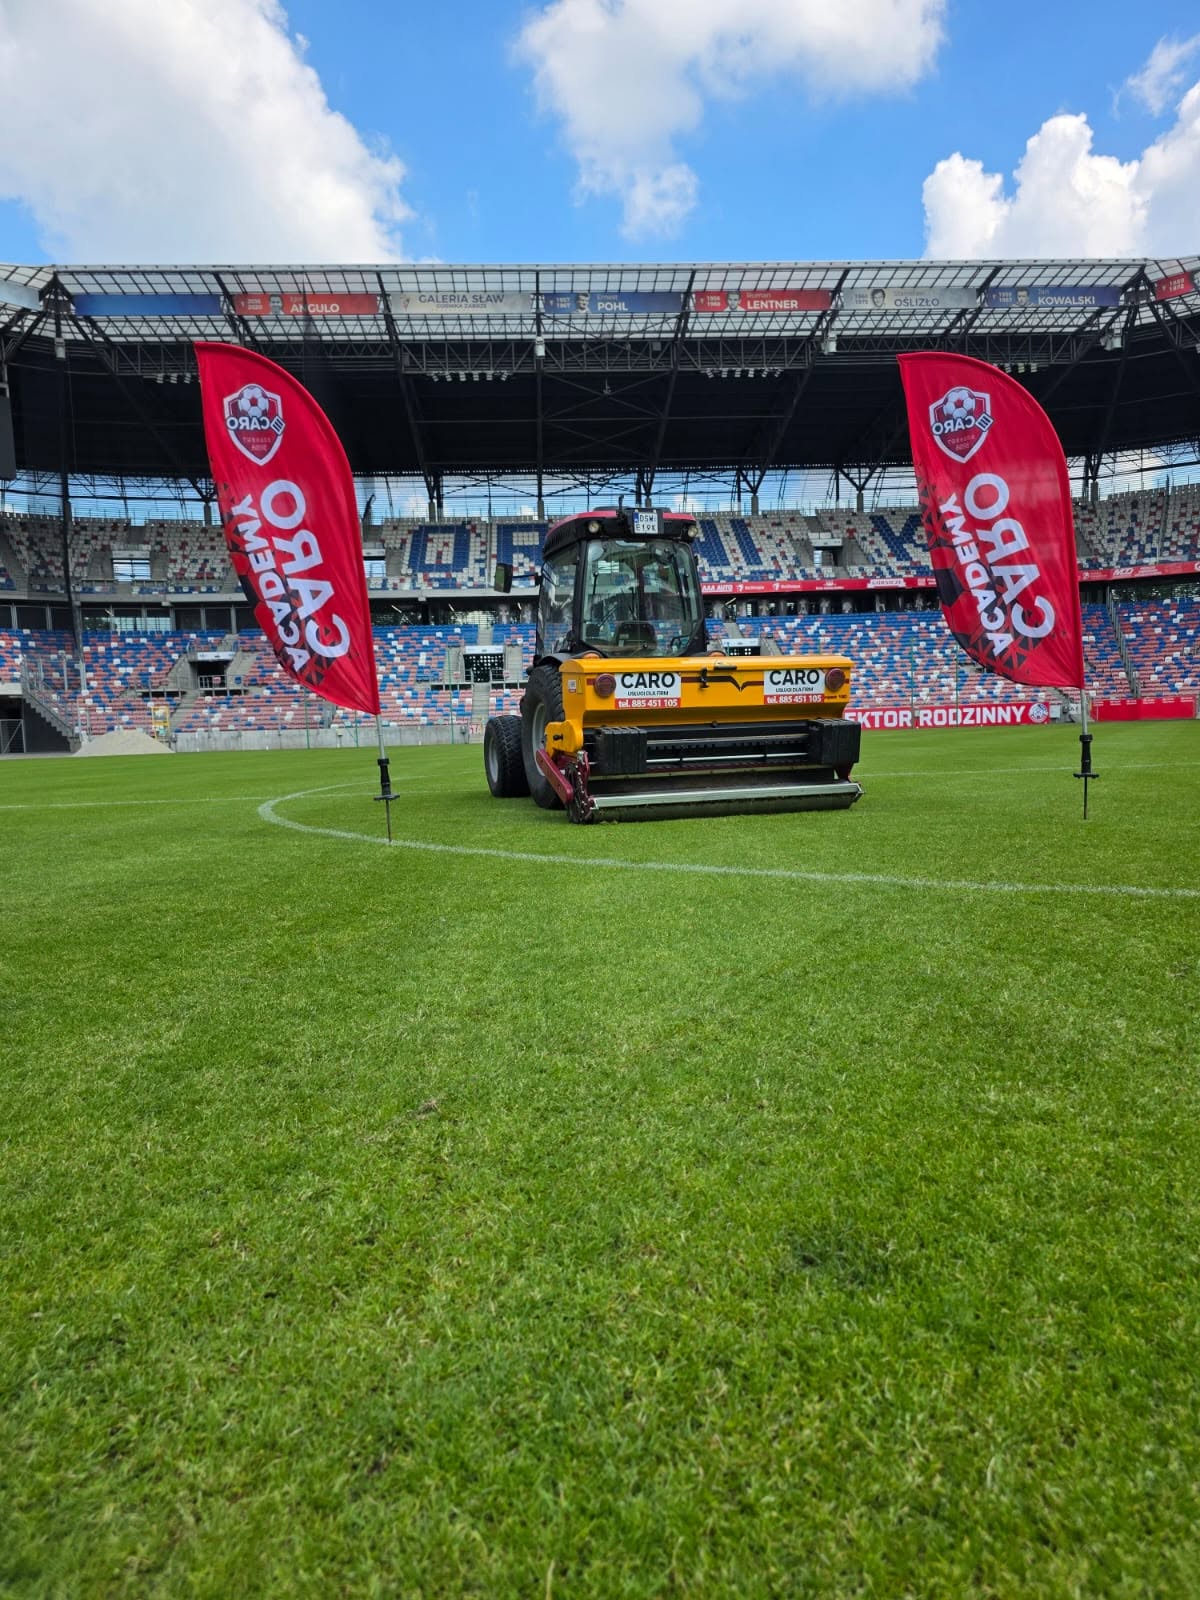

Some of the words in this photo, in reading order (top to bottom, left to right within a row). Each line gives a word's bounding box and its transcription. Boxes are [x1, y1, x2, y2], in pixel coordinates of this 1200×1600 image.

[418, 294, 472, 304] GALERIA
[475, 294, 505, 304] SŁAW
[894, 297, 940, 307] OŚLIZŁO
[1038, 296, 1095, 305] KOWALSKI
[290, 303, 340, 313] ANGULO
[597, 302, 629, 311] POHL
[746, 300, 798, 310] LENTNER
[621, 672, 675, 689] CARO
[769, 669, 820, 686] CARO
[632, 699, 646, 708] 885
[647, 699, 662, 707] 451
[664, 698, 678, 707] 105
[794, 695, 807, 703] 451
[809, 694, 822, 702] 105
[845, 710, 912, 729] EKTOR
[919, 706, 1026, 727] RODZINNY
